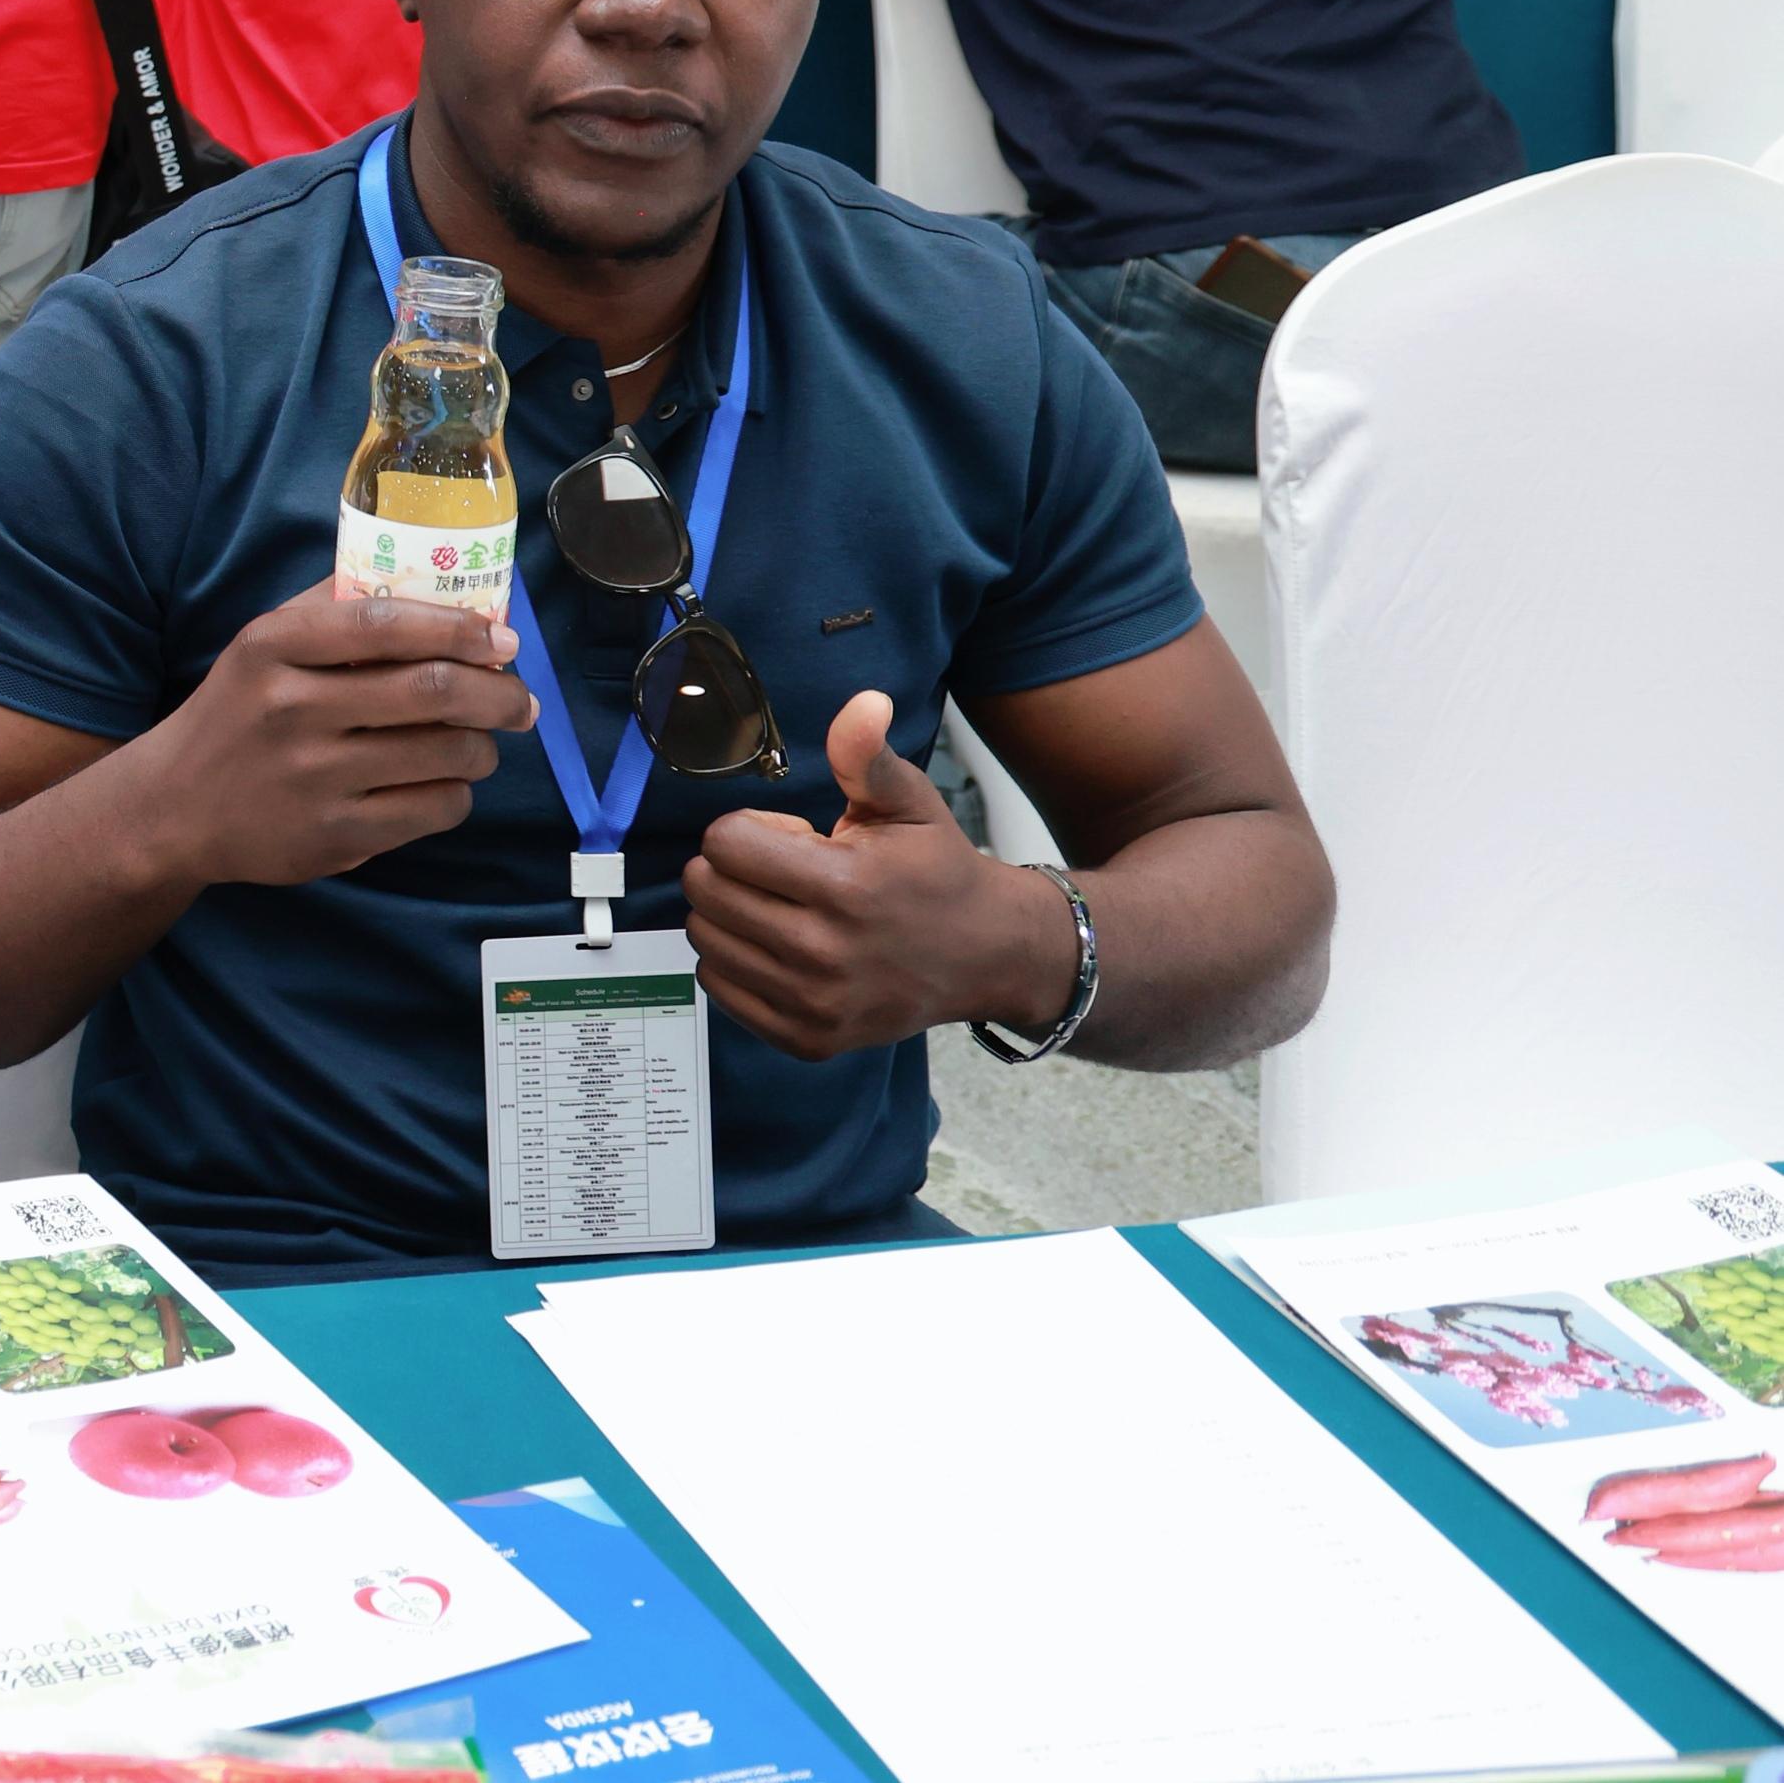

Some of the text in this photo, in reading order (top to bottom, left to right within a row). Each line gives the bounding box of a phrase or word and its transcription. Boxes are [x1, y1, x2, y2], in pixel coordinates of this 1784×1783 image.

[132, 46, 185, 194] WONDER & AMOR
[461, 529, 518, 571] 金果
[32, 1634, 102, 1658] FOOD
[544, 1699, 635, 1732] AGENDA
[511, 1710, 715, 1781] 会议议程
